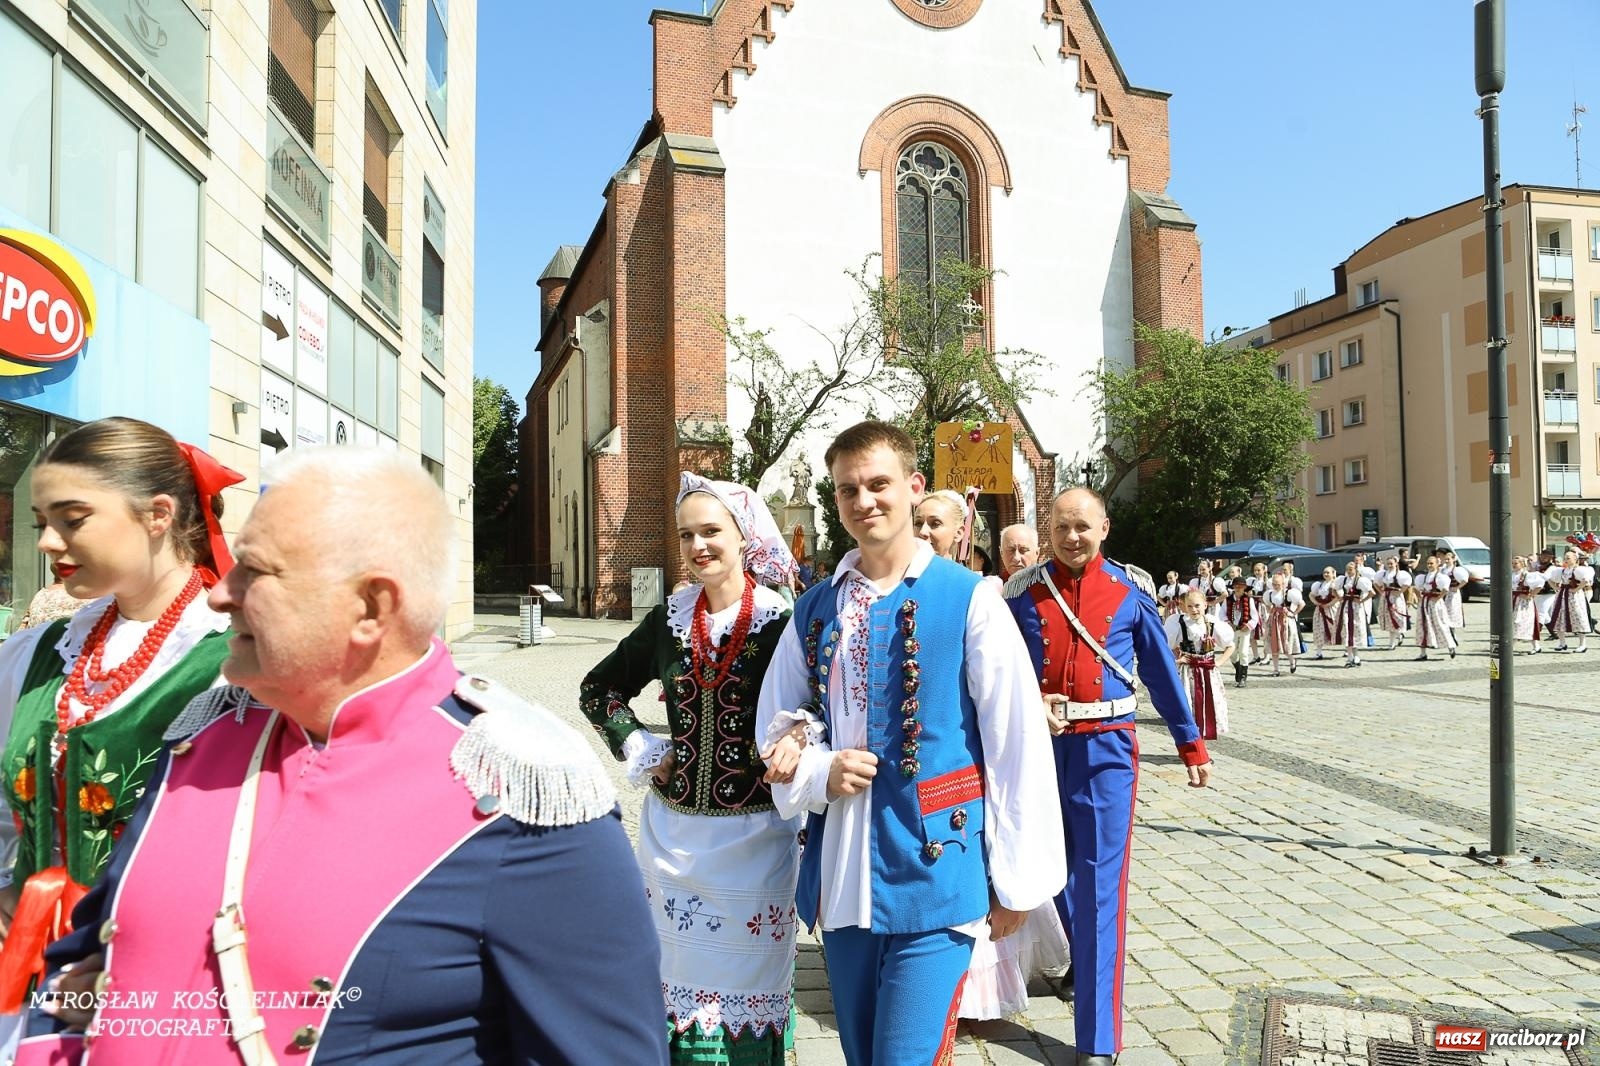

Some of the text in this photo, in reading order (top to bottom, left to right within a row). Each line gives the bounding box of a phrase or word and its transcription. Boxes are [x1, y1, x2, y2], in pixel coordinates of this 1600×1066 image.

[272, 146, 324, 222] KOFEINKA
[269, 275, 291, 306] PIĘTRO
[0, 271, 75, 344] PCO
[265, 390, 290, 416] PIĘTRO
[950, 467, 993, 475] ESTRADA
[1548, 511, 1600, 532] STEL
